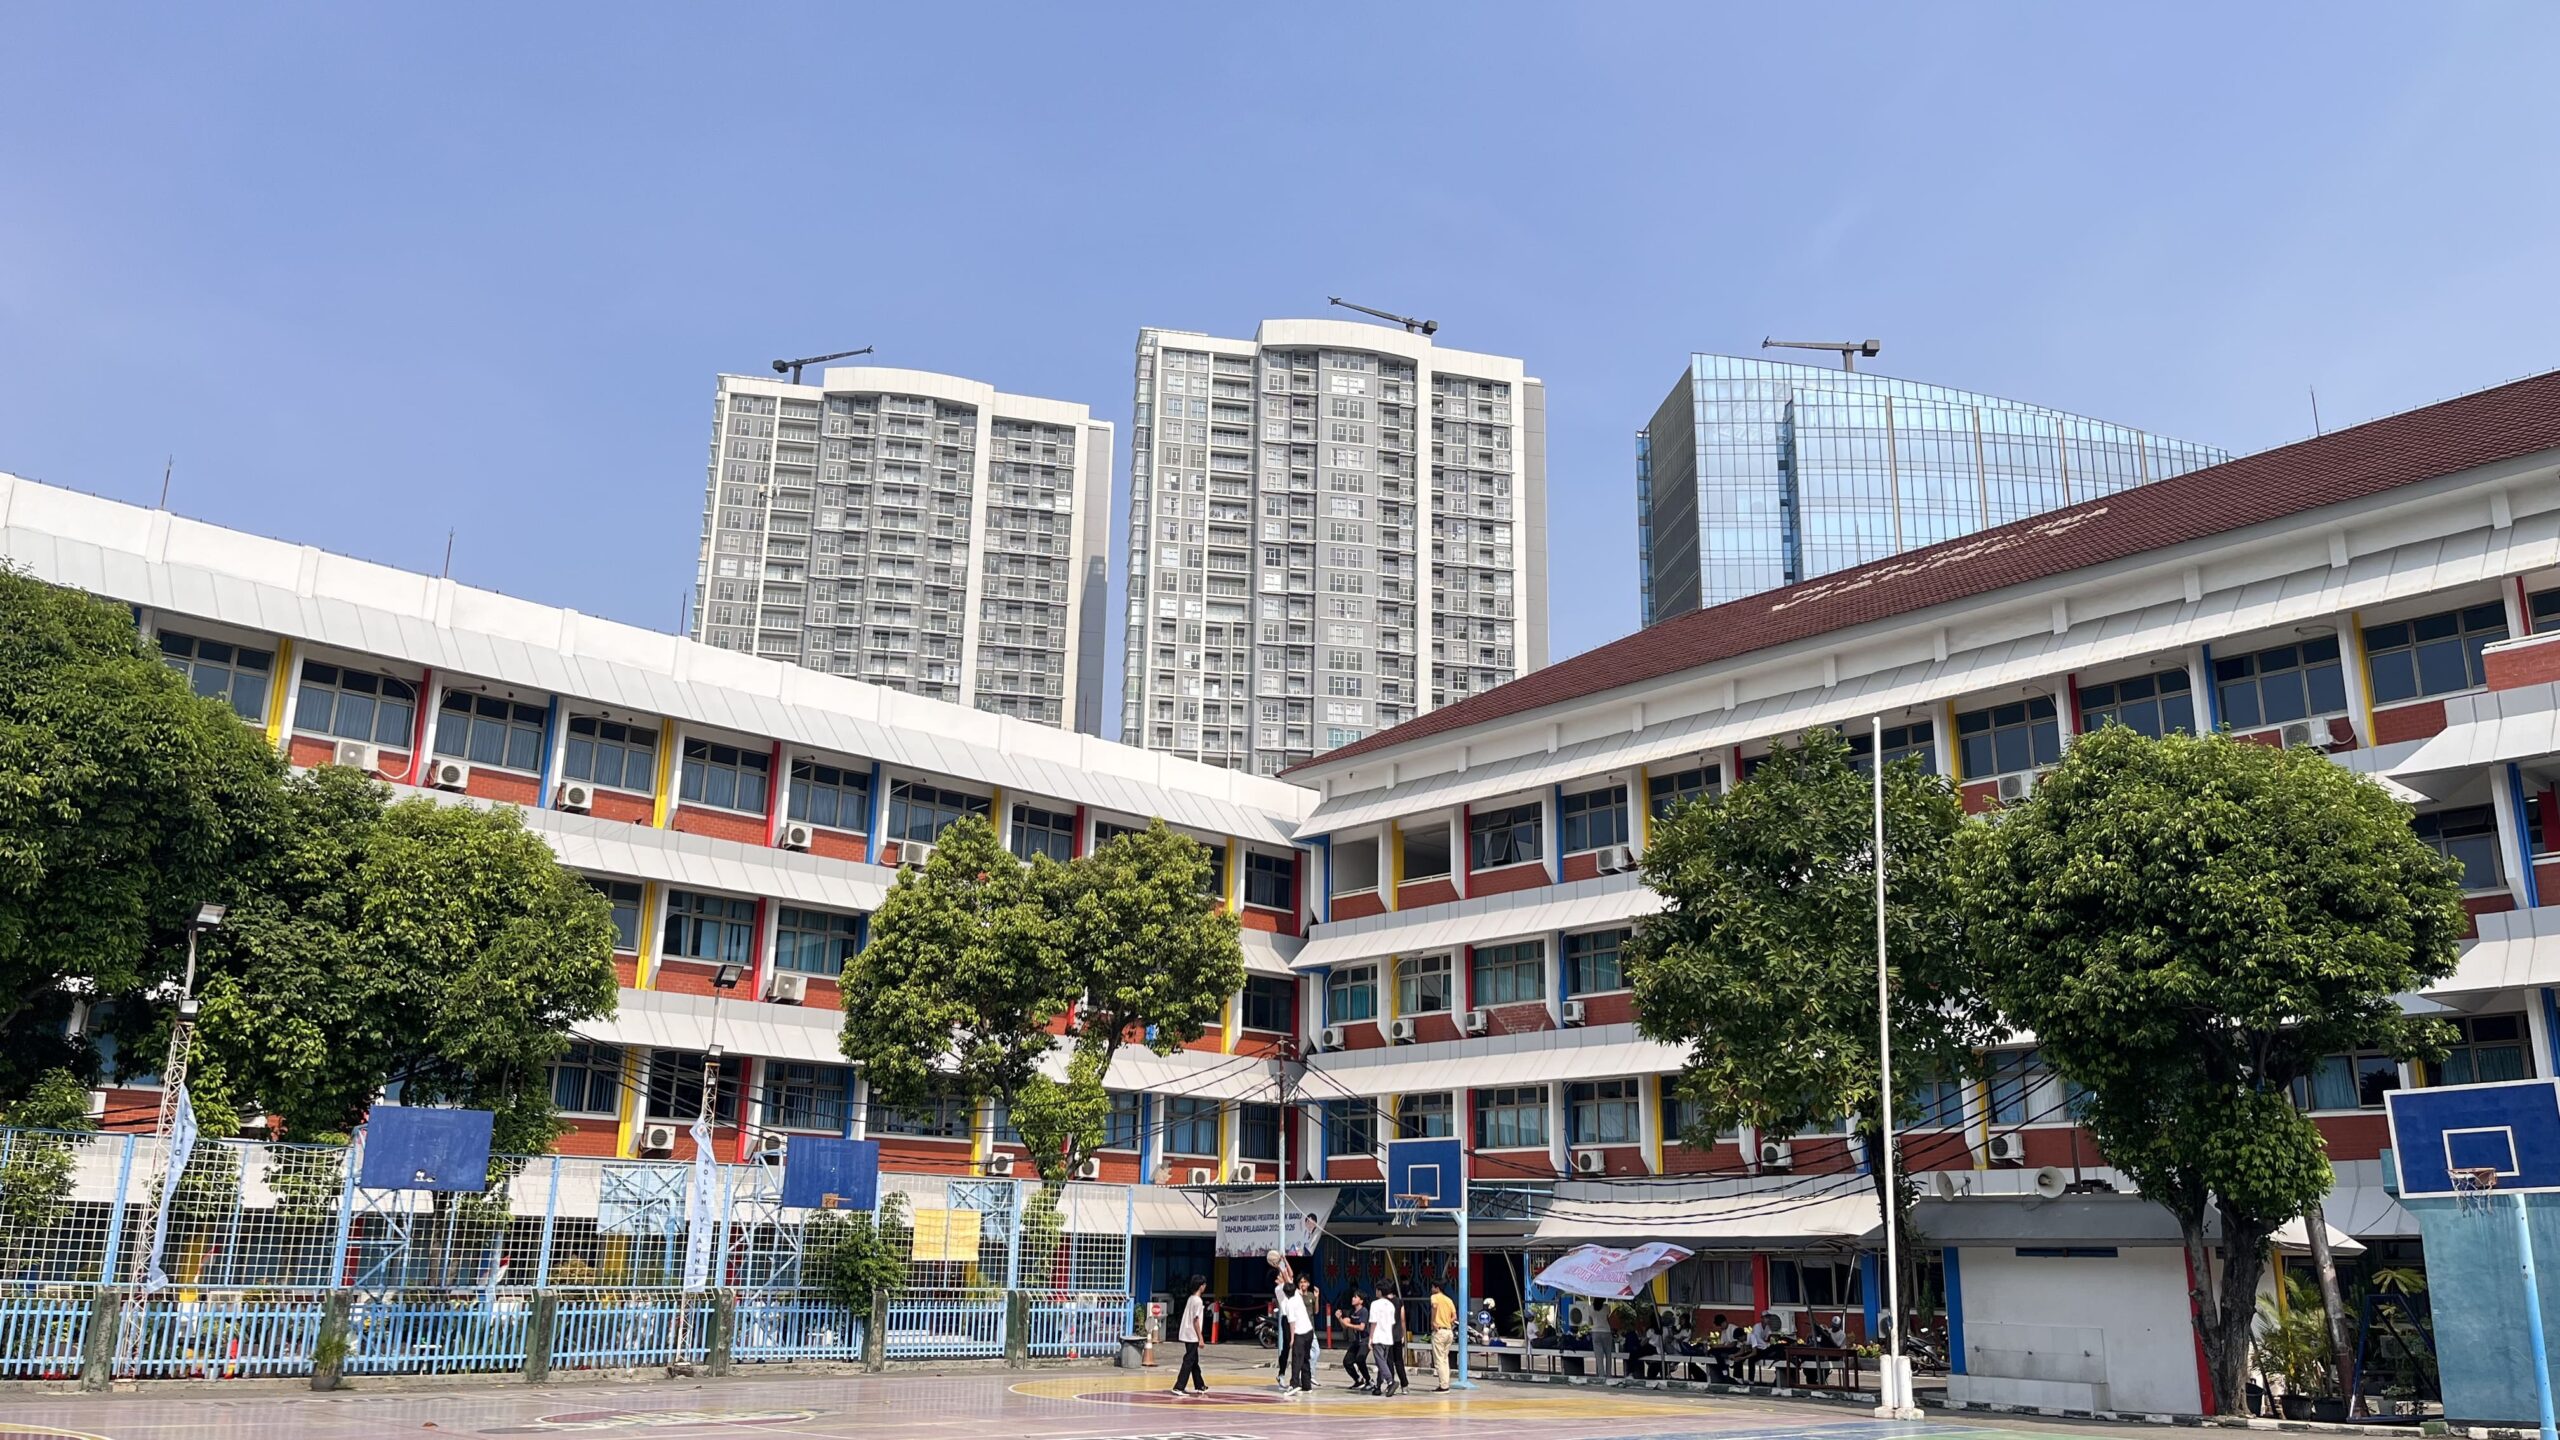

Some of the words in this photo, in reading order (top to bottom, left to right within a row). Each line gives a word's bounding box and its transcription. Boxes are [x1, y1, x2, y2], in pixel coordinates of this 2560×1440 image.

[701, 1159, 710, 1205] KOLAH
[1289, 1212, 1302, 1220] BARU
[692, 1217, 705, 1285] VIANNEY
